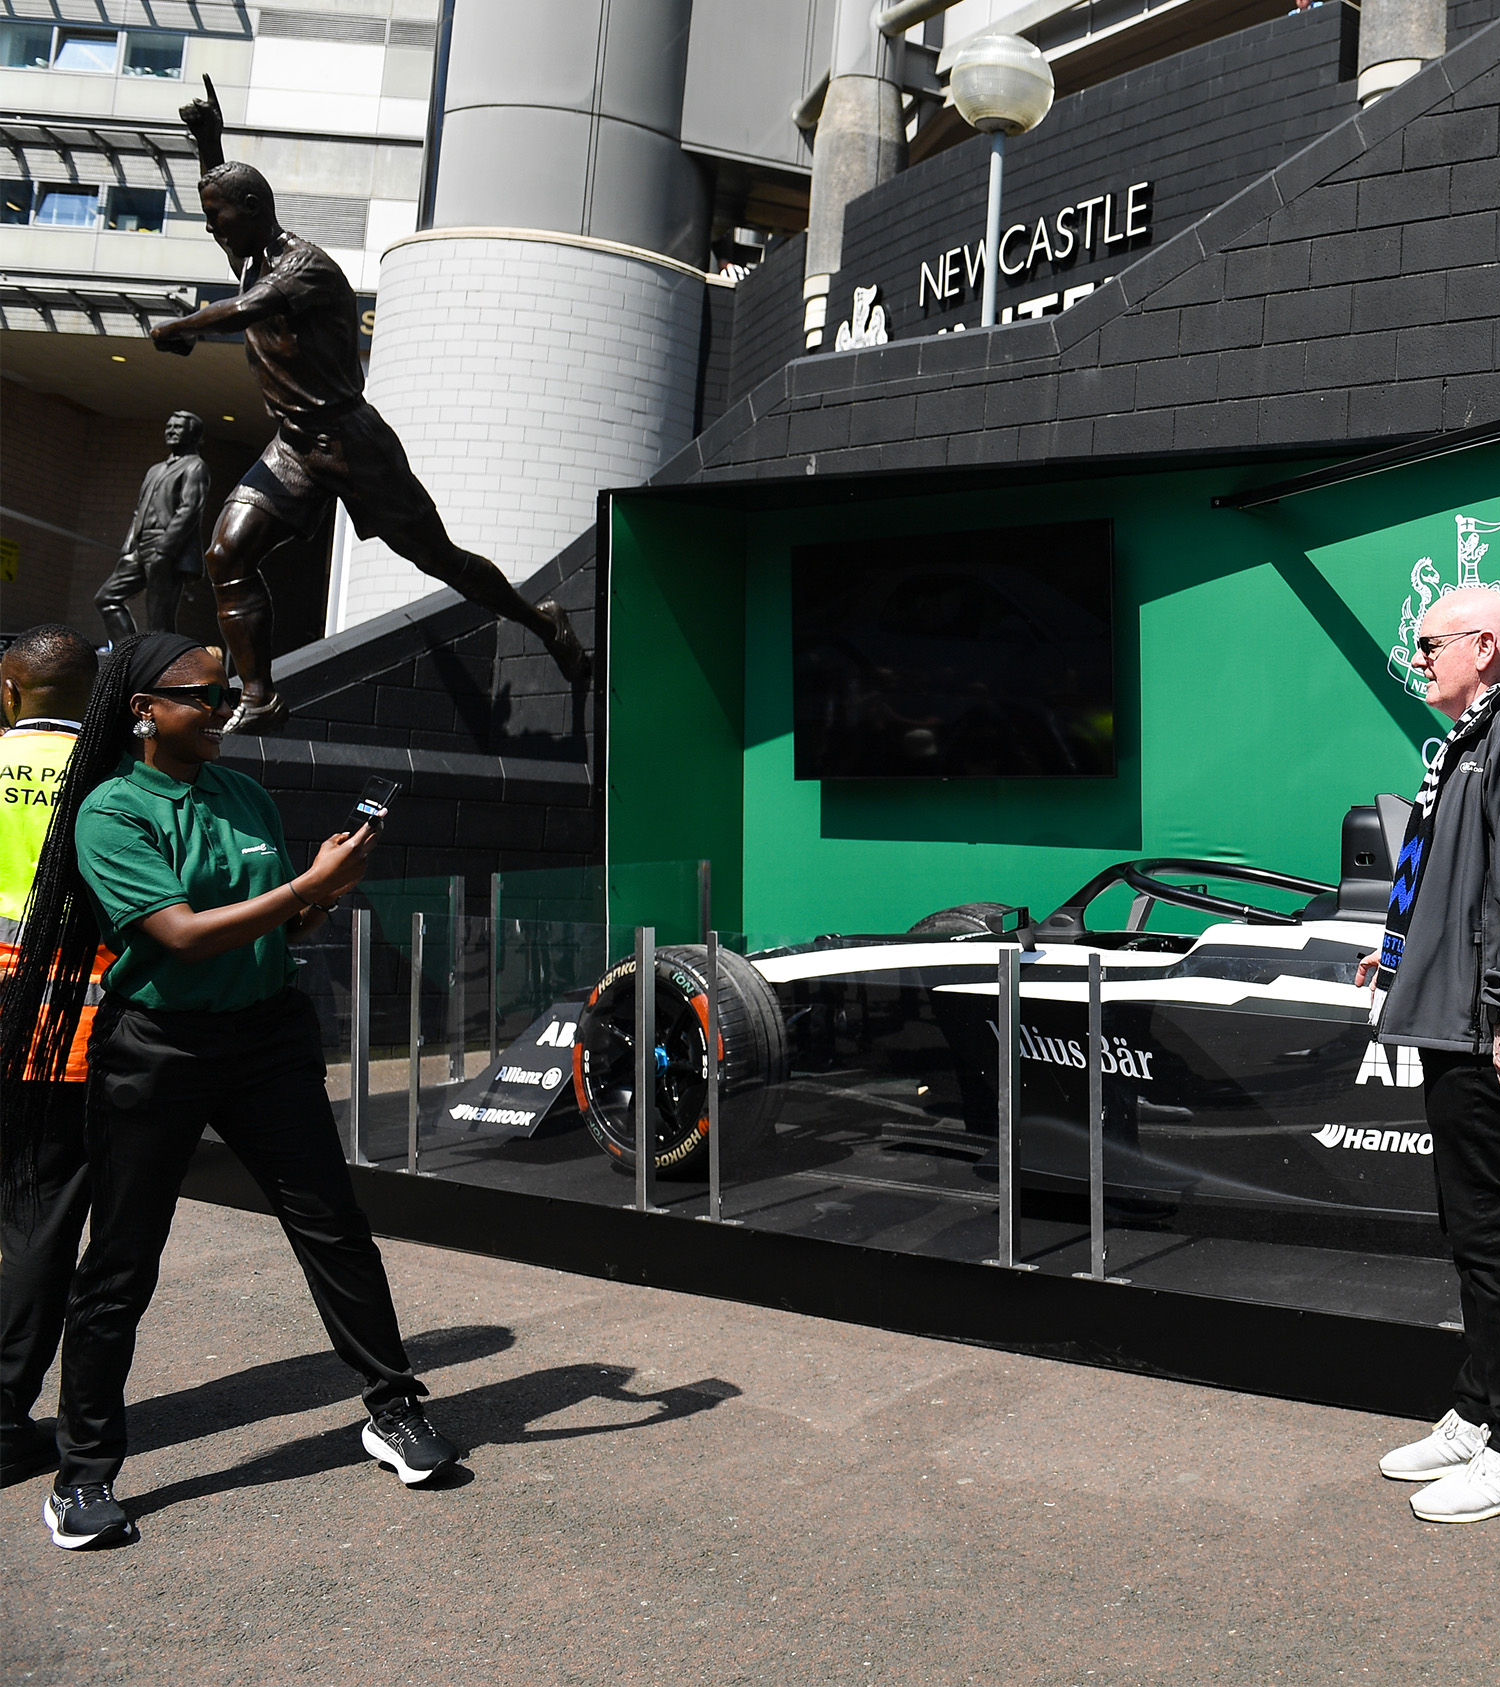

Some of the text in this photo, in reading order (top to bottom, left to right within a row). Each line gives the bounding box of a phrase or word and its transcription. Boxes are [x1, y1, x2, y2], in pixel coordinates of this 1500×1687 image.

[918, 181, 1149, 308] NEWCASTLE
[0, 765, 33, 781] AR
[536, 1020, 578, 1048] AB
[495, 1066, 543, 1085] Allianz
[1354, 1040, 1425, 1088] AB
